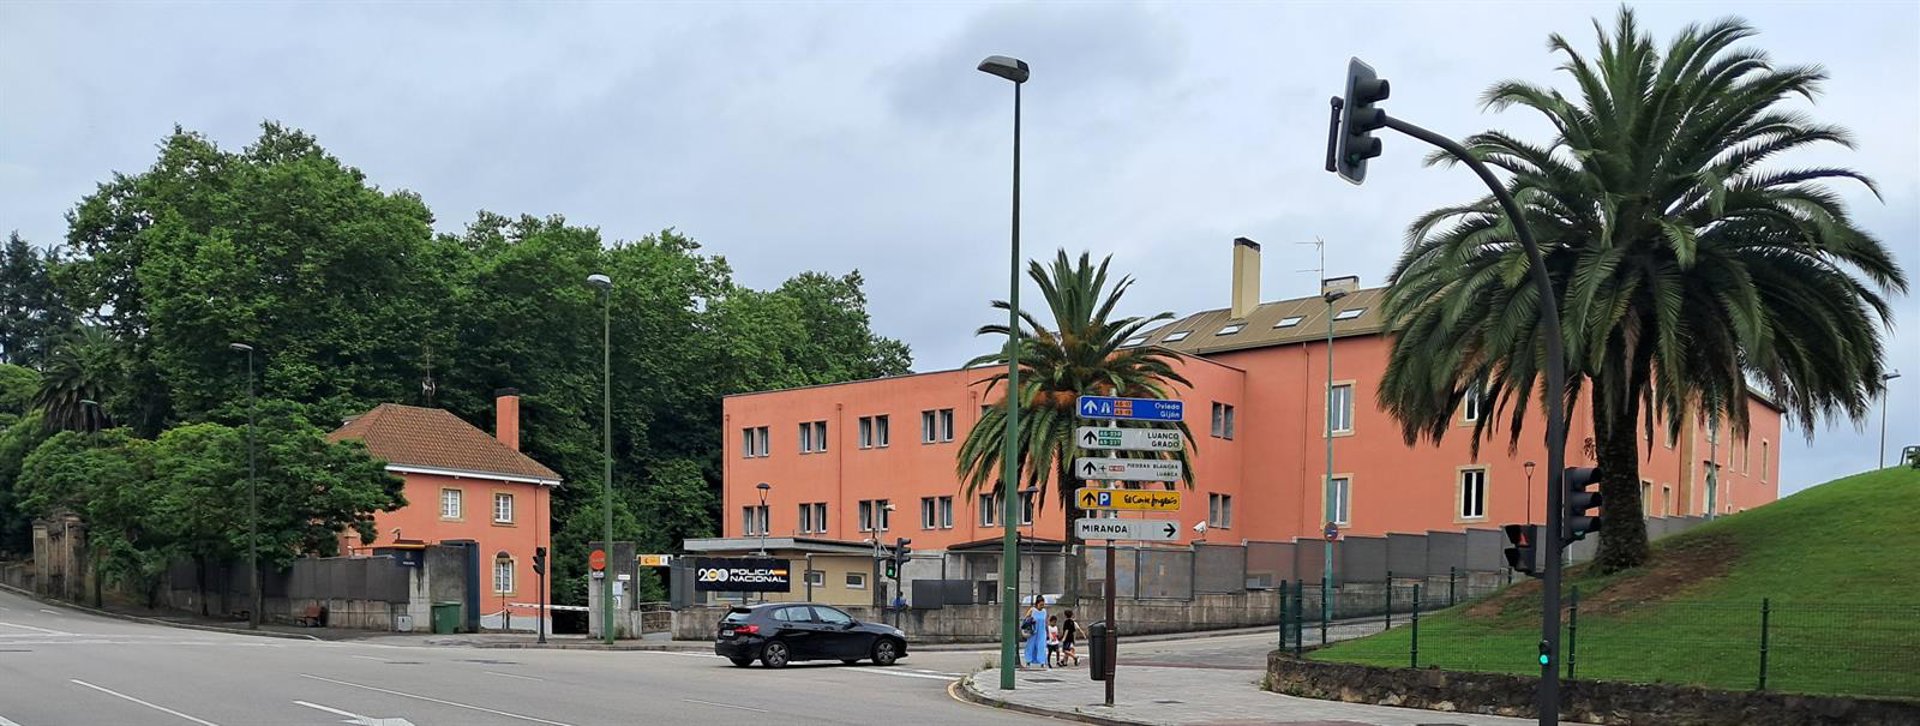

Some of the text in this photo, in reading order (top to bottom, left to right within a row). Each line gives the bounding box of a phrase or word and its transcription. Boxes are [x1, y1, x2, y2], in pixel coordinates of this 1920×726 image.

[1155, 402, 1180, 410] Oviedo
[1160, 411, 1180, 419] Gijón
[1124, 494, 1132, 504] El
[1132, 495, 1150, 504] Corte
[1082, 525, 1128, 533] MIRANDA
[698, 568, 729, 582] 200
[730, 575, 787, 583] NACIONAL
